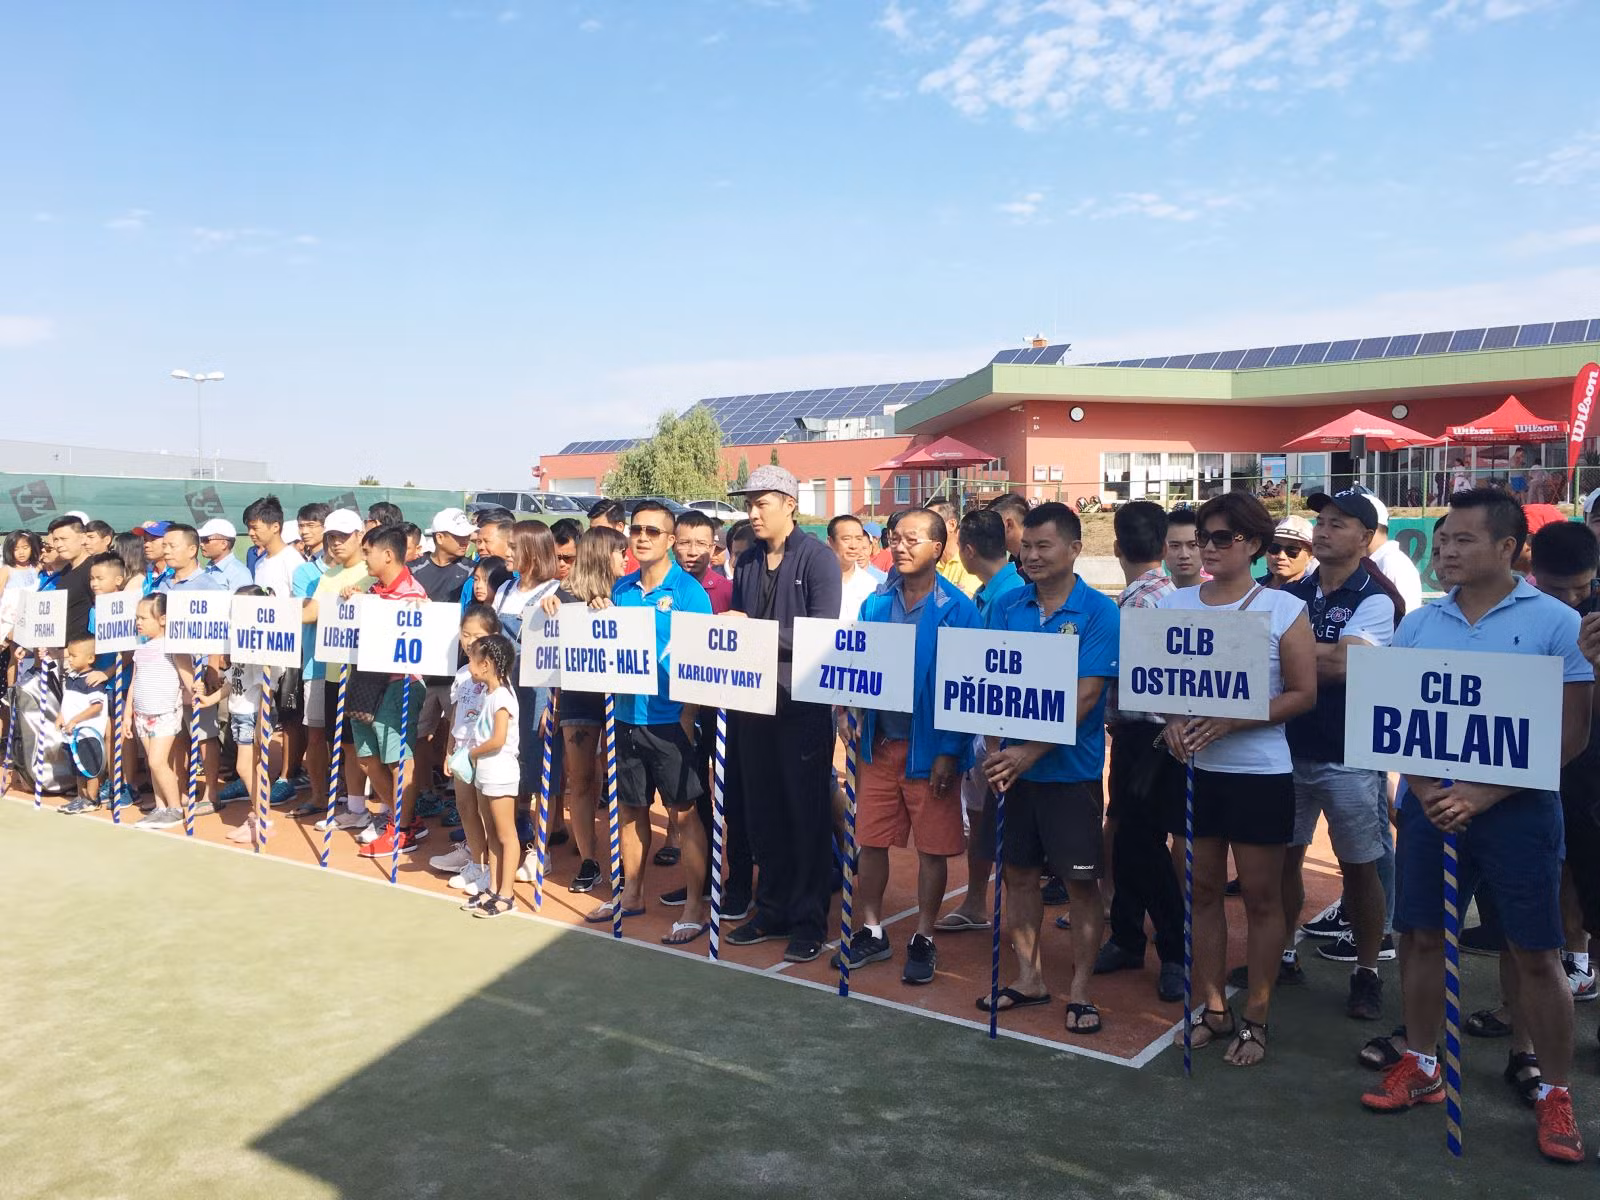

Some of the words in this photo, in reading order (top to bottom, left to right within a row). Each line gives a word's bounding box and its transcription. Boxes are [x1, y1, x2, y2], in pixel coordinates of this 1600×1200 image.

[1570, 370, 1599, 442] Wilson
[1452, 426, 1494, 435] Wilson
[1514, 424, 1558, 433] Wilson
[38, 601, 51, 615] CLB
[110, 600, 124, 615] CLB
[189, 600, 208, 614] CLB
[257, 607, 275, 623] CLB
[338, 603, 355, 620] CLB
[396, 610, 422, 627] CLB
[34, 623, 55, 638] PRAHA
[187, 621, 203, 639] NAD
[204, 621, 229, 640] LABEN
[236, 625, 264, 653] VIỆT
[266, 631, 295, 652] NAM
[591, 619, 618, 639] CLB
[708, 628, 738, 652] CLB
[834, 629, 867, 652] CLB
[1166, 626, 1215, 656] CLB
[393, 631, 423, 664] ÁO
[565, 647, 607, 674] LEIPZIG
[616, 649, 650, 675] HALE
[984, 648, 1023, 675] CLB
[677, 663, 729, 685] KARLOVY
[730, 669, 763, 689] VARY
[819, 664, 883, 696] ZITTAU
[1131, 666, 1250, 700] OSTRAVA
[943, 675, 1066, 723] PŘÍBRAM
[1420, 671, 1482, 707] CLB
[1372, 705, 1530, 770] BALAN
